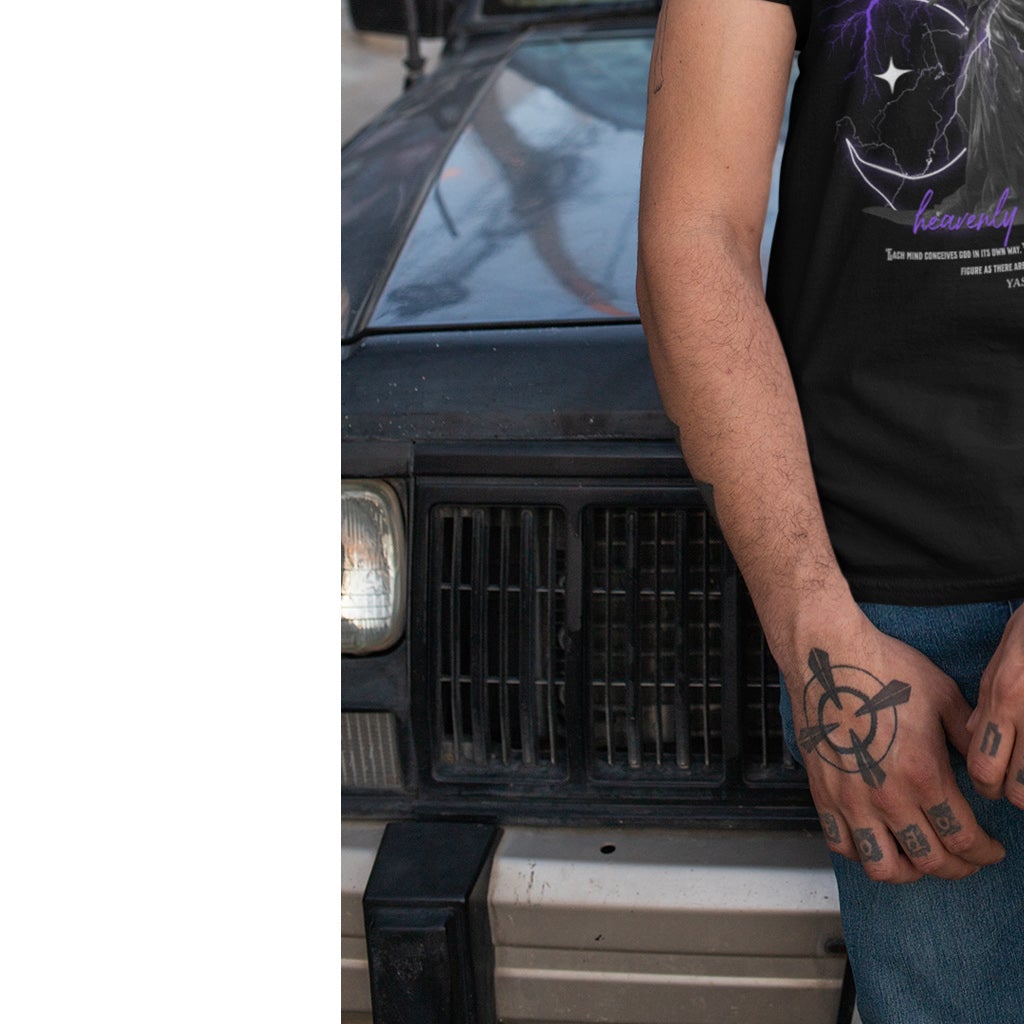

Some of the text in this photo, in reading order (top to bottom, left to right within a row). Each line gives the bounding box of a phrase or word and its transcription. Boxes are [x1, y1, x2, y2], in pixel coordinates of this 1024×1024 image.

[912, 187, 1018, 247] heavenly
[906, 251, 923, 261] MIND
[924, 251, 958, 261] CONCEIVES
[959, 250, 972, 259] GOD
[972, 249, 980, 258] IN
[980, 248, 991, 258] ITS
[991, 247, 1006, 257] OWN
[1006, 245, 1022, 256] WAY.
[960, 265, 982, 276] FIGURE
[983, 265, 992, 274] AS
[993, 263, 1013, 273] THERE
